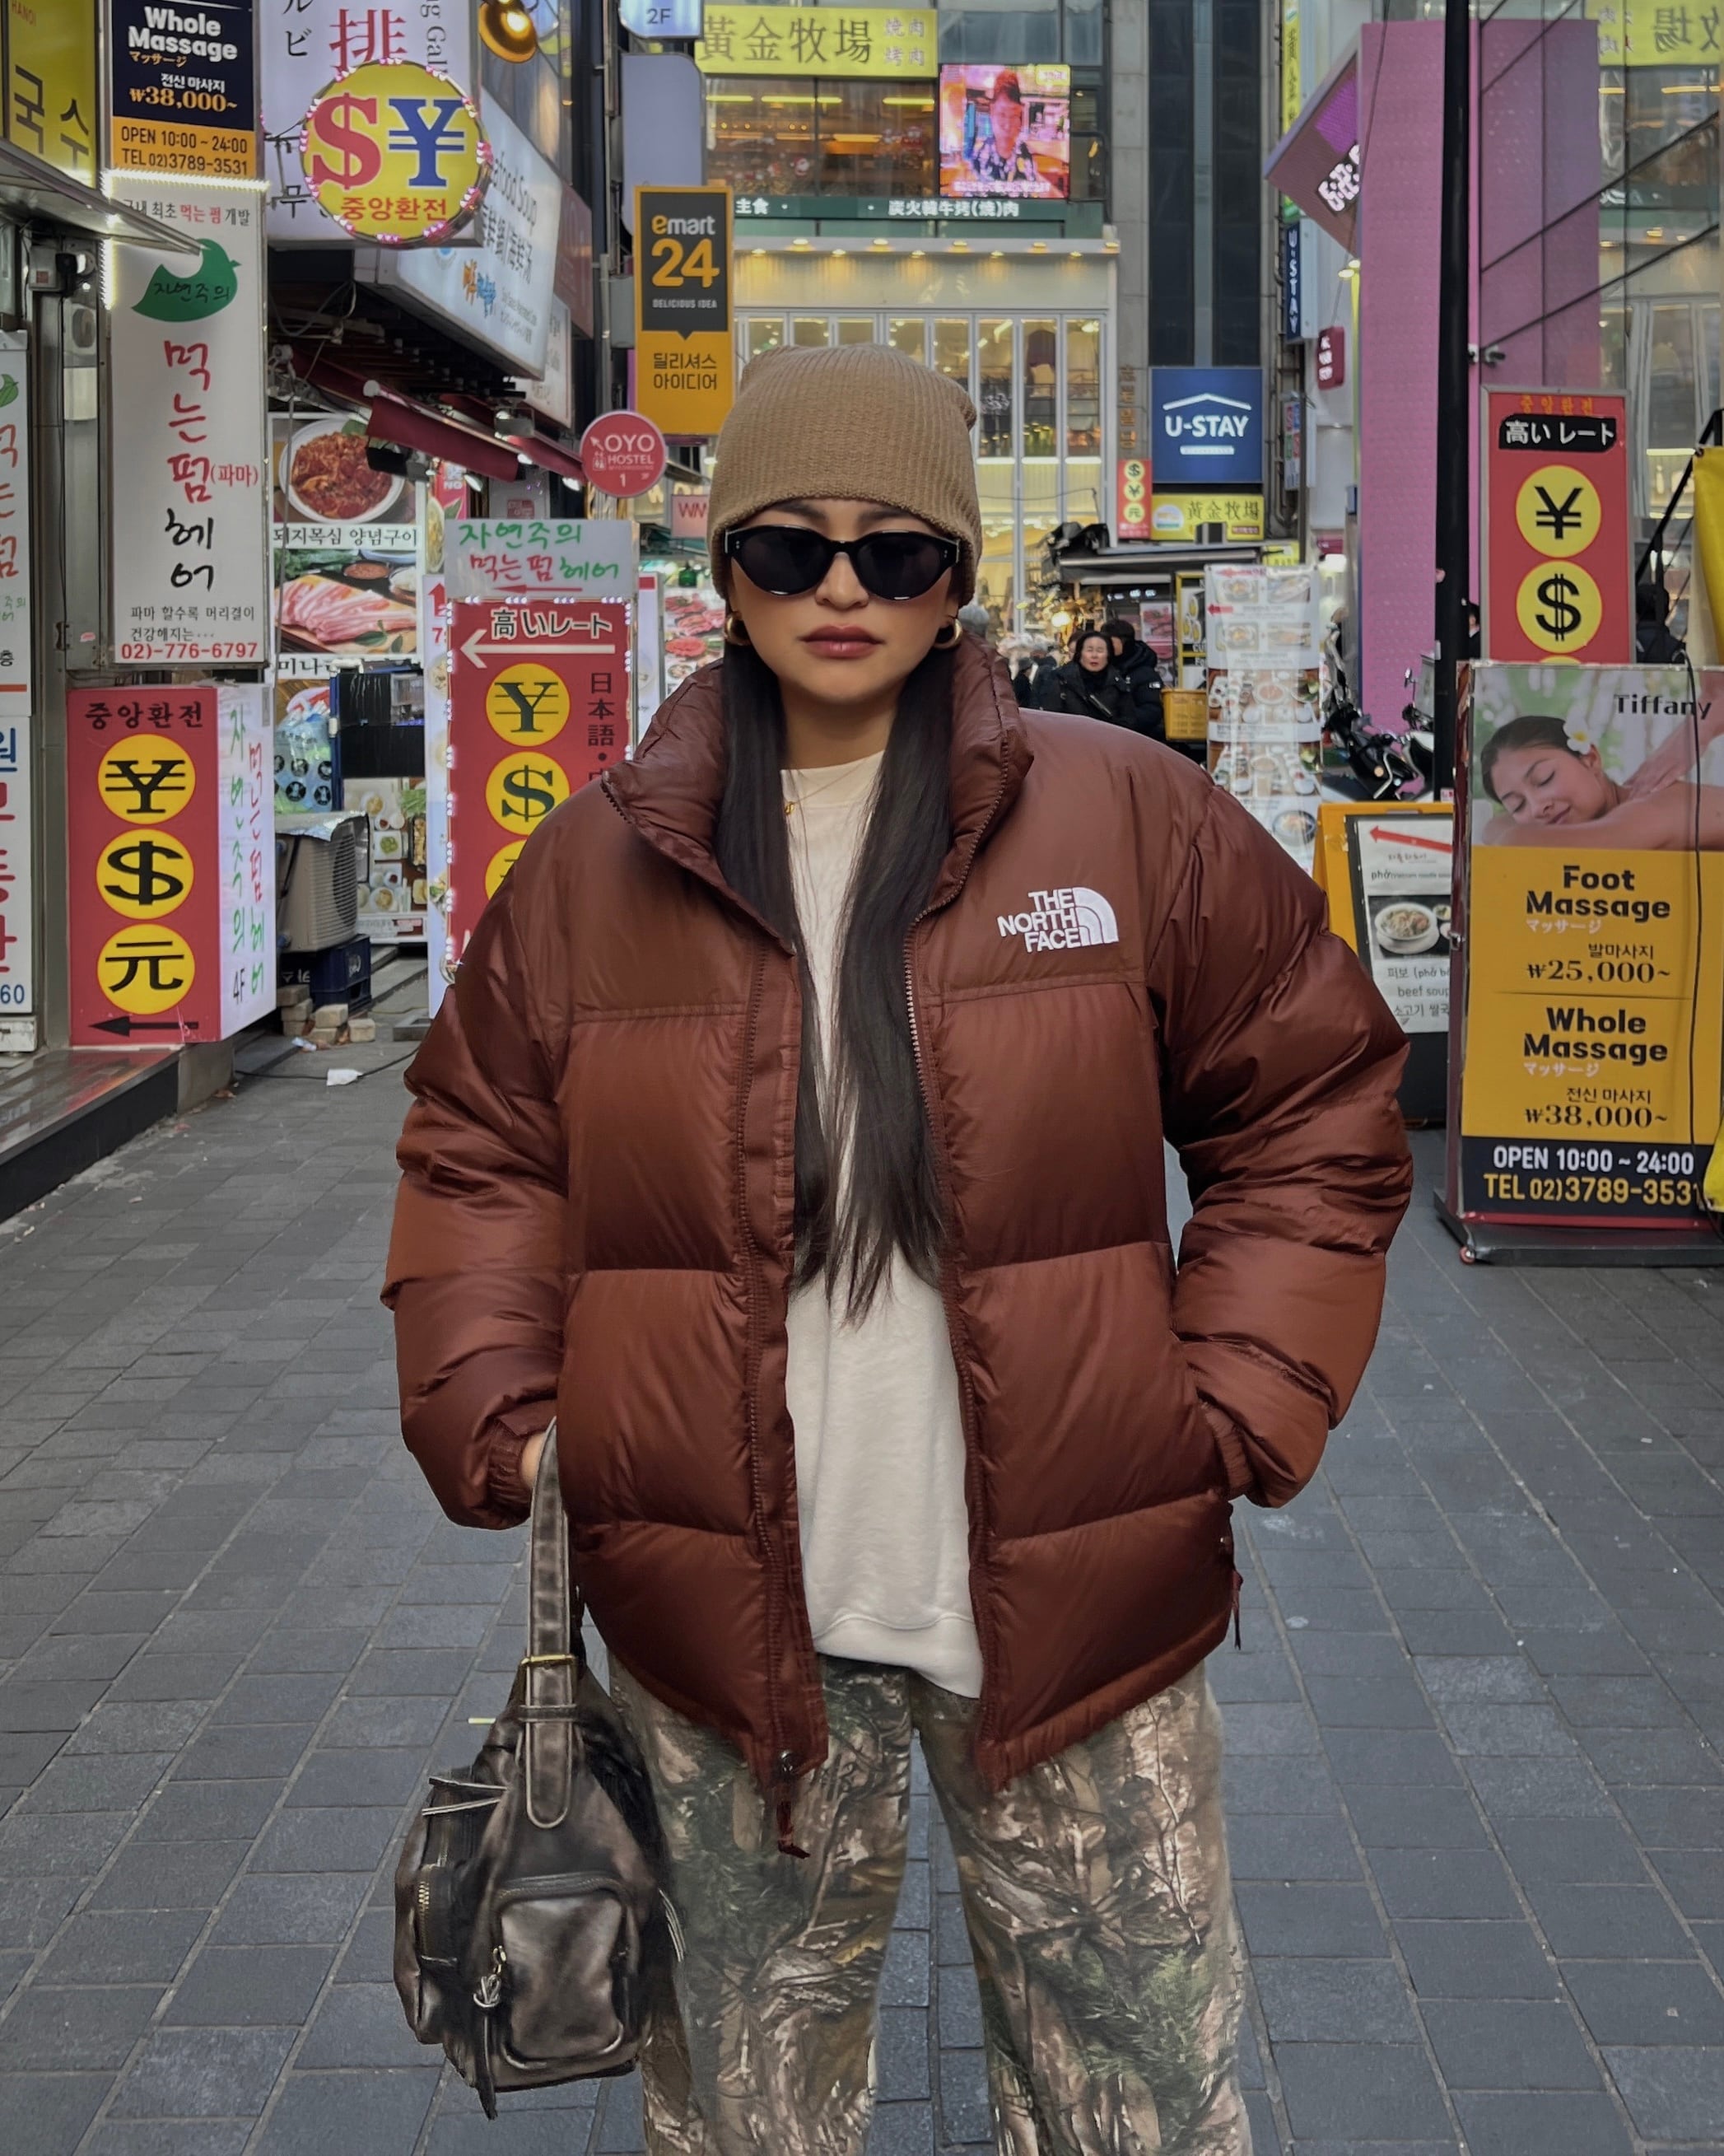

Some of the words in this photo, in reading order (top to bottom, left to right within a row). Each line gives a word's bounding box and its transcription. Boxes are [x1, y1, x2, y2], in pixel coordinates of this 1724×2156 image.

[144, 7, 221, 36] Whole
[646, 8, 671, 26] 2F
[128, 26, 238, 62] Massage
[129, 50, 187, 68] マッサージ
[161, 72, 185, 89] 전신
[187, 77, 226, 93] 마사지
[14, 64, 90, 170] 국수
[121, 126, 156, 145] OPEN
[161, 130, 197, 149] 10:00
[212, 135, 248, 154] 24:00
[123, 148, 147, 166] TEL
[149, 152, 248, 175] 02)3789-3531
[151, 201, 177, 220] 최초
[179, 203, 206, 223] 먹는
[225, 208, 250, 227] 개발
[340, 197, 448, 222] 중앙환전
[735, 198, 769, 215] 主食
[651, 215, 715, 236] emart
[651, 238, 720, 287] 24
[652, 298, 696, 309] DELICIOUS
[697, 299, 718, 309] IDEA
[654, 352, 717, 370] 딜리셔스
[653, 373, 718, 390] 아이디어
[1165, 415, 1249, 438] U-STAY
[1506, 418, 1615, 446] 高いレート
[604, 434, 655, 452] OYO
[608, 455, 655, 465] HOSTEL
[211, 464, 259, 488] (파마)
[349, 527, 417, 548] 양념구이
[459, 522, 583, 550] 자연주의
[470, 554, 522, 582] 먹는
[559, 557, 619, 581] 헤어
[131, 604, 156, 621] 파마
[161, 604, 198, 622] 할수록
[206, 604, 254, 622] 머리결이
[491, 608, 612, 641] 高いレート
[121, 642, 259, 660] 02)-776-6797
[85, 701, 203, 730] 중앙환전
[1613, 693, 1712, 721] Tiffany
[1563, 865, 1636, 891] Foot
[1028, 888, 1075, 912] THE
[1526, 890, 1670, 922] Massage
[996, 907, 1078, 937] NORTH
[1526, 918, 1602, 935] マッサージ
[1024, 927, 1082, 953] FACE
[1588, 942, 1654, 960] 발마사지
[105, 940, 185, 992] 元
[233, 967, 246, 1006] 4F
[1397, 985, 1423, 998] beef
[1394, 1004, 1424, 1018] 소고기
[1546, 1006, 1647, 1034] Whole
[1524, 1034, 1668, 1066] Massage
[1523, 1062, 1600, 1077] マッサージ
[1567, 1087, 1597, 1104] 전신
[1602, 1088, 1652, 1104] 마사지
[1493, 1145, 1549, 1170] OPEN
[1557, 1148, 1613, 1173] 10:00
[1636, 1150, 1694, 1176] 24:00
[1483, 1173, 1526, 1200] TEL
